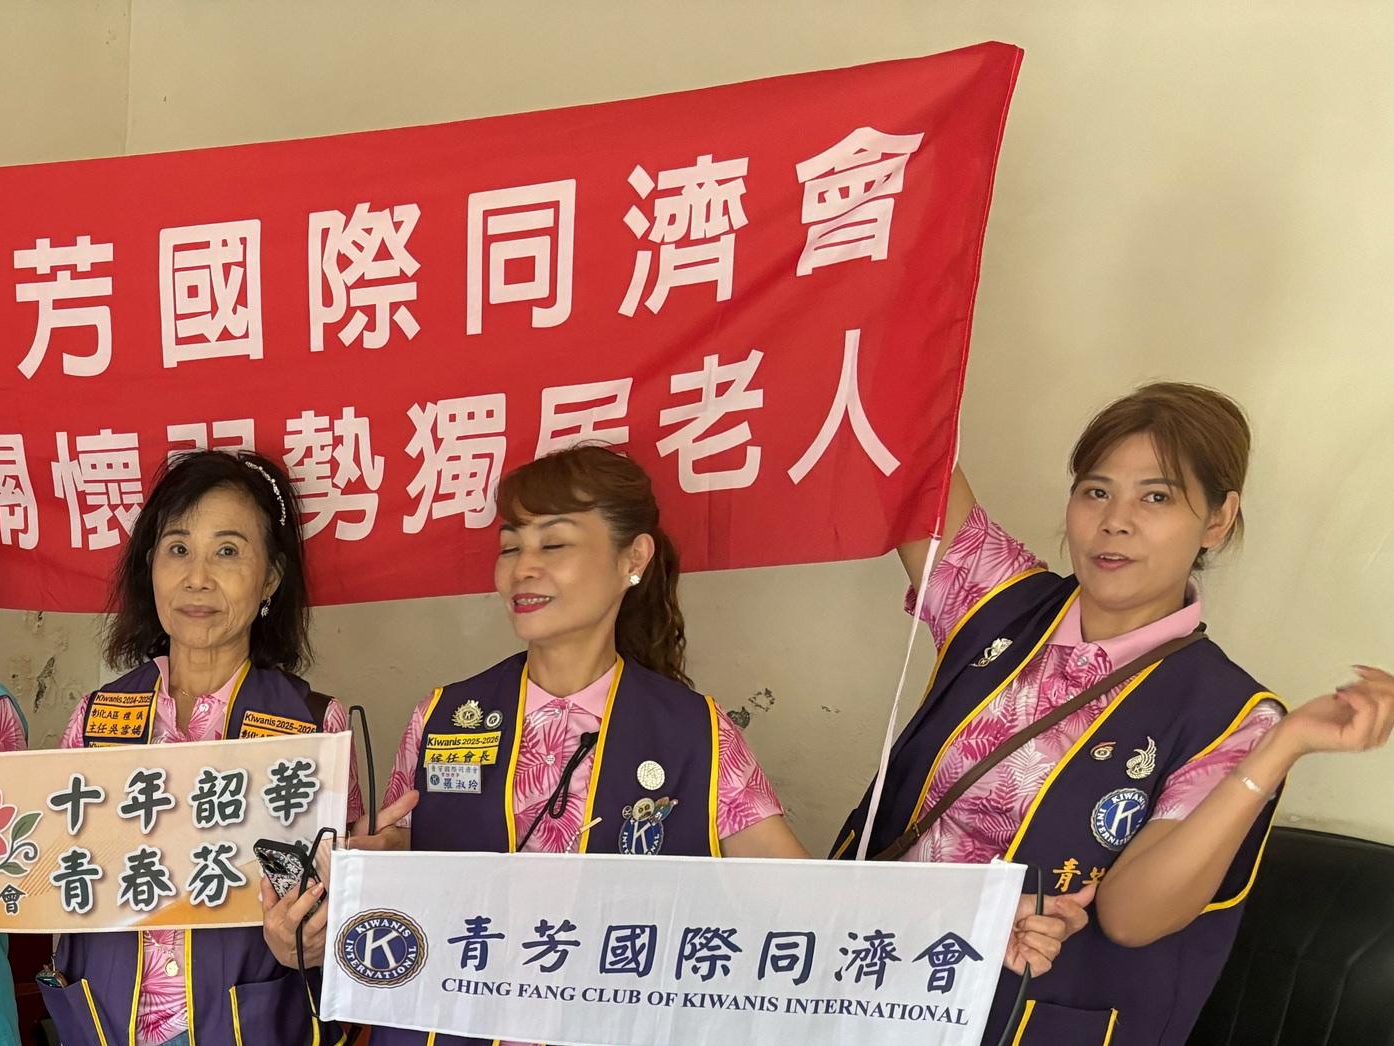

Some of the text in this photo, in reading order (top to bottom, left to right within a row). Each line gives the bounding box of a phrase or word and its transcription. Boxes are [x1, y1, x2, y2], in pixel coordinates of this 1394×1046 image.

[95, 694, 123, 704] Kiwanis
[245, 713, 276, 727] Kiwanis
[427, 735, 499, 747] Kiwanis 2025-2026
[49, 757, 319, 834] 十年韶華
[50, 840, 313, 914] 青春芬
[355, 919, 412, 937] KIWANIS
[345, 939, 418, 979] INTERNATIONAL
[447, 915, 984, 994] 青芳國際同濟會
[441, 977, 970, 1026] CHING FANG CLUB OF KIWANIS INTERNATIONAL
